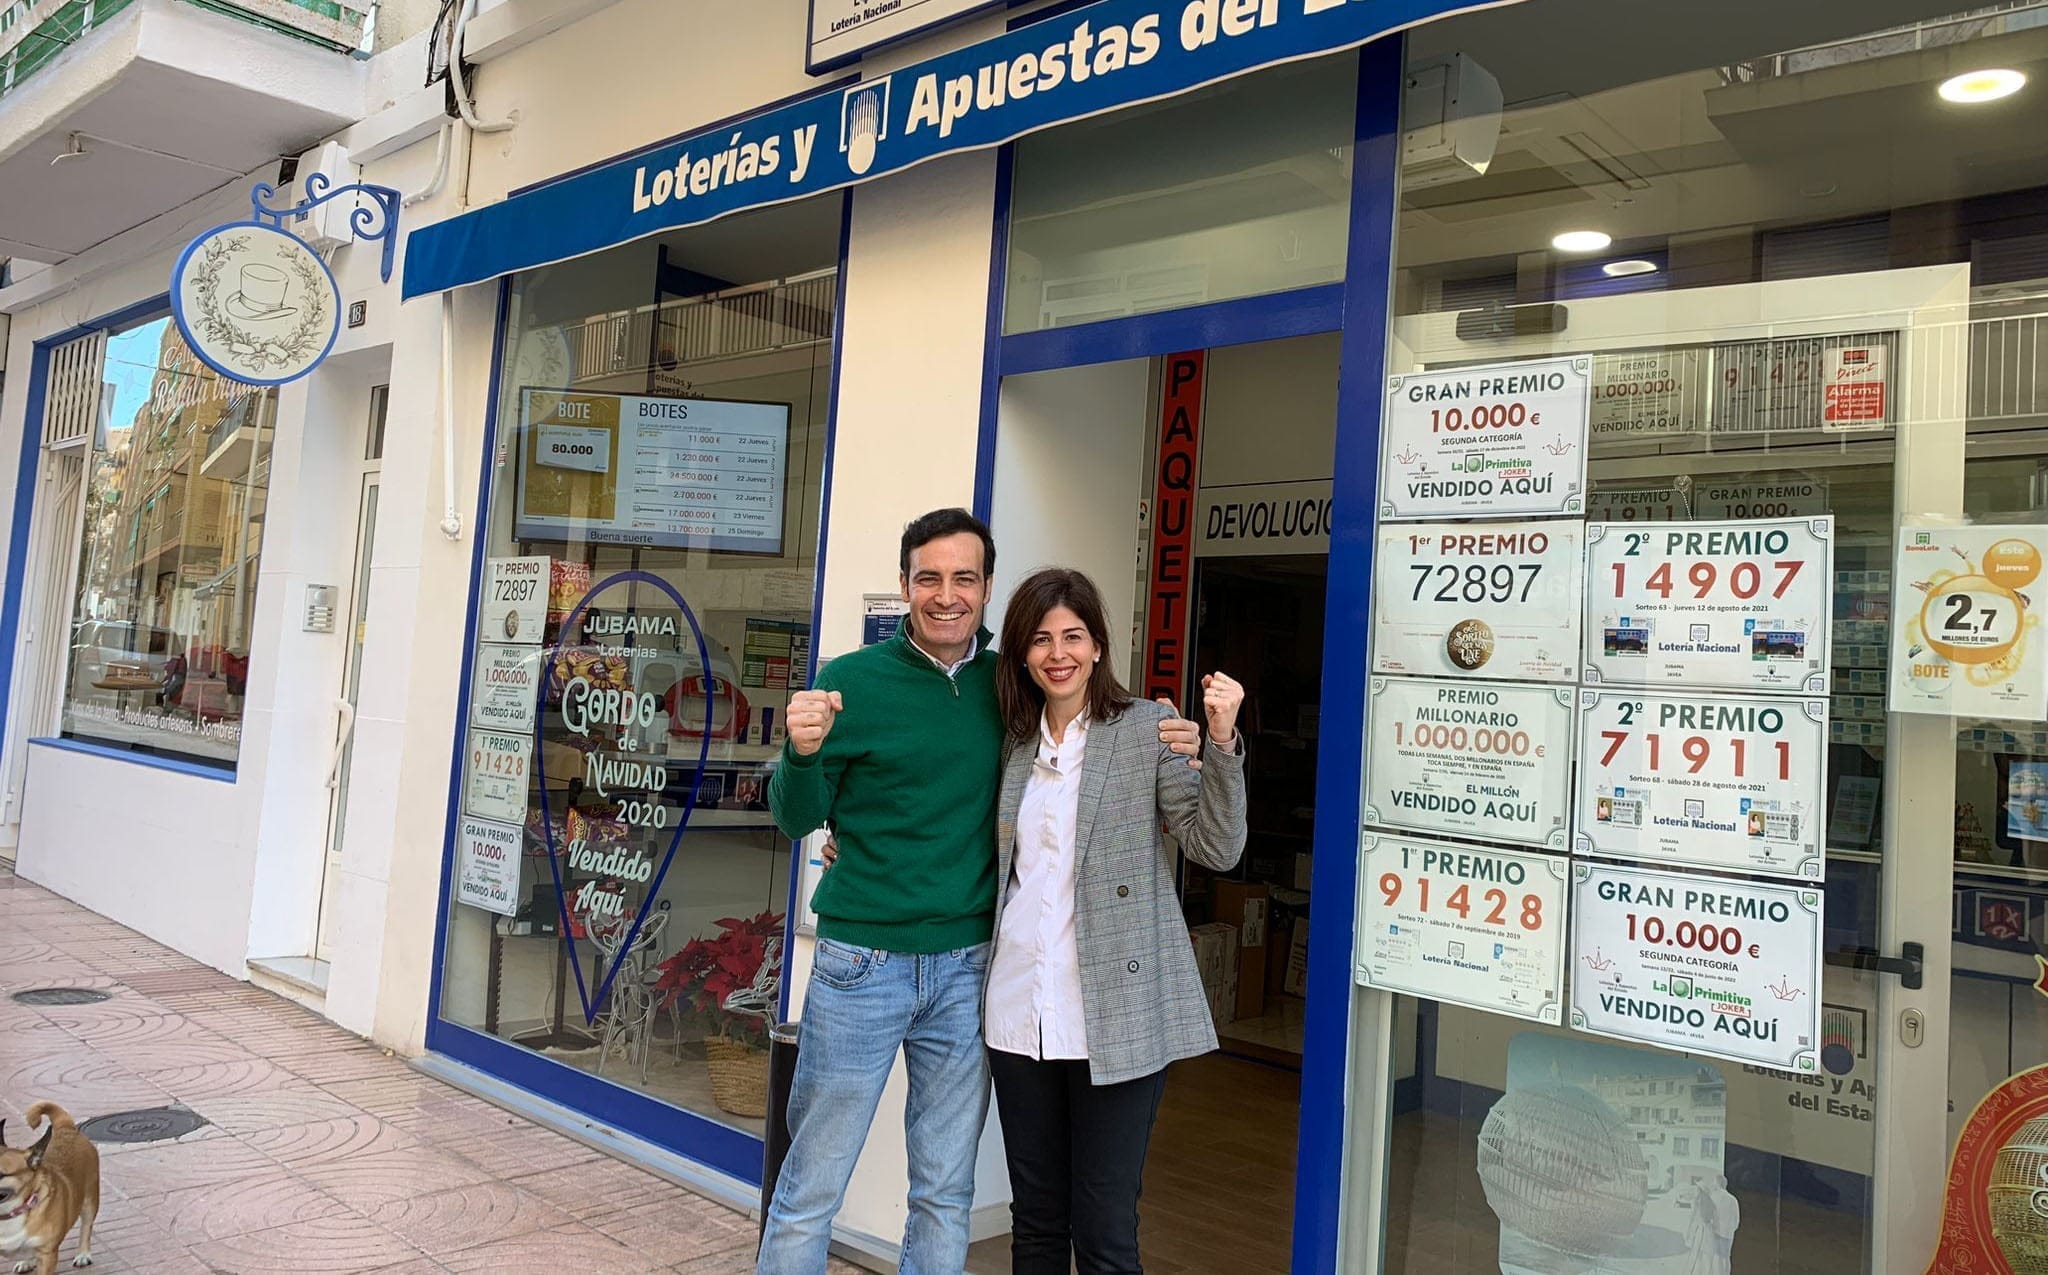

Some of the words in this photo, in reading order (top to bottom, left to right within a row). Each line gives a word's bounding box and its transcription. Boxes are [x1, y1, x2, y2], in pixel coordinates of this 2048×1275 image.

[863, 0, 901, 21] Nacional
[632, 129, 780, 213] Loterías
[790, 124, 817, 182] y
[905, 15, 1161, 138] Apuestas
[1180, 0, 1278, 51] del
[351, 304, 362, 323] 18
[1620, 361, 1657, 371] PREMIO
[1837, 362, 1879, 380] Direct
[1607, 370, 1669, 383] MILLONARIO
[1409, 381, 1471, 403] GRAN
[1479, 372, 1565, 396] PREMIO
[1594, 379, 1675, 399] 1.000.000
[1829, 386, 1880, 396] Alarma
[558, 401, 590, 419] BOTE
[639, 402, 688, 419] BOTES
[1431, 403, 1526, 433] 10.000
[1530, 413, 1540, 425] €
[1592, 421, 1645, 433] VENDIDO
[1649, 414, 1680, 428] AQUÍ
[748, 438, 769, 446] Jueves
[1441, 436, 1477, 446] SEGUNDA
[1479, 432, 1523, 442] CATEGORÍA
[552, 443, 593, 455] 80.000
[747, 457, 768, 465] Jueves
[1451, 462, 1463, 471] La
[1485, 458, 1532, 469] Primitiva
[746, 476, 767, 484] Jueves
[1407, 479, 1493, 499] VENDIDO
[1500, 472, 1553, 496] AQUÍ
[744, 495, 766, 503] Jueves
[1611, 491, 1671, 504] PREMIO
[1710, 488, 1750, 500] GRAN
[1757, 486, 1812, 498] PREMIO
[1725, 503, 1788, 519] 10.000
[590, 530, 620, 542] Buena
[623, 533, 653, 544] suerte
[1409, 536, 1431, 555] 1er
[1440, 532, 1549, 555] PREMIO
[1624, 532, 1650, 556] 2º
[1666, 530, 1789, 556] PREMIO
[505, 562, 540, 575] PREMIO
[1995, 563, 2030, 573] jueves
[1410, 564, 1543, 603] 72897
[1611, 560, 1805, 600] 14907
[495, 579, 537, 601] 72897
[1673, 604, 1695, 612] jueves
[1717, 605, 1739, 613] agosto
[1944, 593, 1998, 634] 2,7
[583, 616, 675, 636] JUBAMA
[1659, 642, 1693, 652] Lotería
[1697, 643, 1741, 653] Nacional
[1913, 664, 1949, 678] BOTE
[562, 676, 657, 735] GORDO
[1438, 688, 1499, 705] PREMIO
[481, 706, 508, 718] VENDIDO
[1416, 707, 1518, 727] MILLONARIO
[1617, 701, 1643, 726] 2º
[1659, 703, 1783, 733] PREMIO
[489, 737, 520, 753] PREMIO
[618, 730, 637, 751] de
[1394, 722, 1530, 756] 1.000.000
[1535, 745, 1545, 758] €
[474, 750, 523, 776] 91428
[1599, 730, 1789, 780] 71911
[585, 752, 667, 797] NAVIDAD
[1629, 775, 1650, 783] Sorteo
[1667, 778, 1690, 787] sábado
[1712, 783, 1736, 791] agosto
[1748, 784, 1766, 792] 2021
[1466, 784, 1478, 794] EL
[1480, 785, 1519, 798] MILLÓN
[616, 800, 667, 829] 2020
[1391, 790, 1476, 815] VENDIDO
[1483, 801, 1537, 822] AQUÍ
[1653, 815, 1689, 828] Lotería
[1691, 819, 1736, 832] Nacional
[465, 825, 486, 838] GRAN
[487, 829, 514, 844] PREMIO
[473, 841, 502, 861] 10.000
[569, 837, 652, 883] Vendido
[1423, 850, 1526, 886] PREMIO
[463, 882, 489, 897] VENDIDO
[490, 889, 508, 902] AQUÍ
[574, 880, 625, 917] Aquí
[1379, 872, 1543, 931] 91428
[1598, 880, 1674, 909] GRAN
[1684, 890, 1790, 923] PREMIO
[1398, 913, 1416, 922] Sorteo
[1430, 920, 1450, 928] sábado
[1464, 924, 1496, 936] septiembre
[1506, 932, 1520, 940] 2019
[1625, 913, 1742, 955] 10.000
[1747, 943, 1760, 959] €
[1453, 959, 1489, 972] Nacional
[1639, 950, 1684, 964] SEGUNDA
[1686, 957, 1739, 972] CATEGORÍA
[1653, 980, 1667, 992] La
[1694, 986, 1751, 1006] Primitiva
[1600, 993, 1705, 1028] VENDIDO
[1713, 1014, 1778, 1042] AQUÍ
[1717, 1002, 1745, 1014] JOKER
[1831, 1078, 1843, 1095] y
[1788, 1092, 1819, 1111] del
